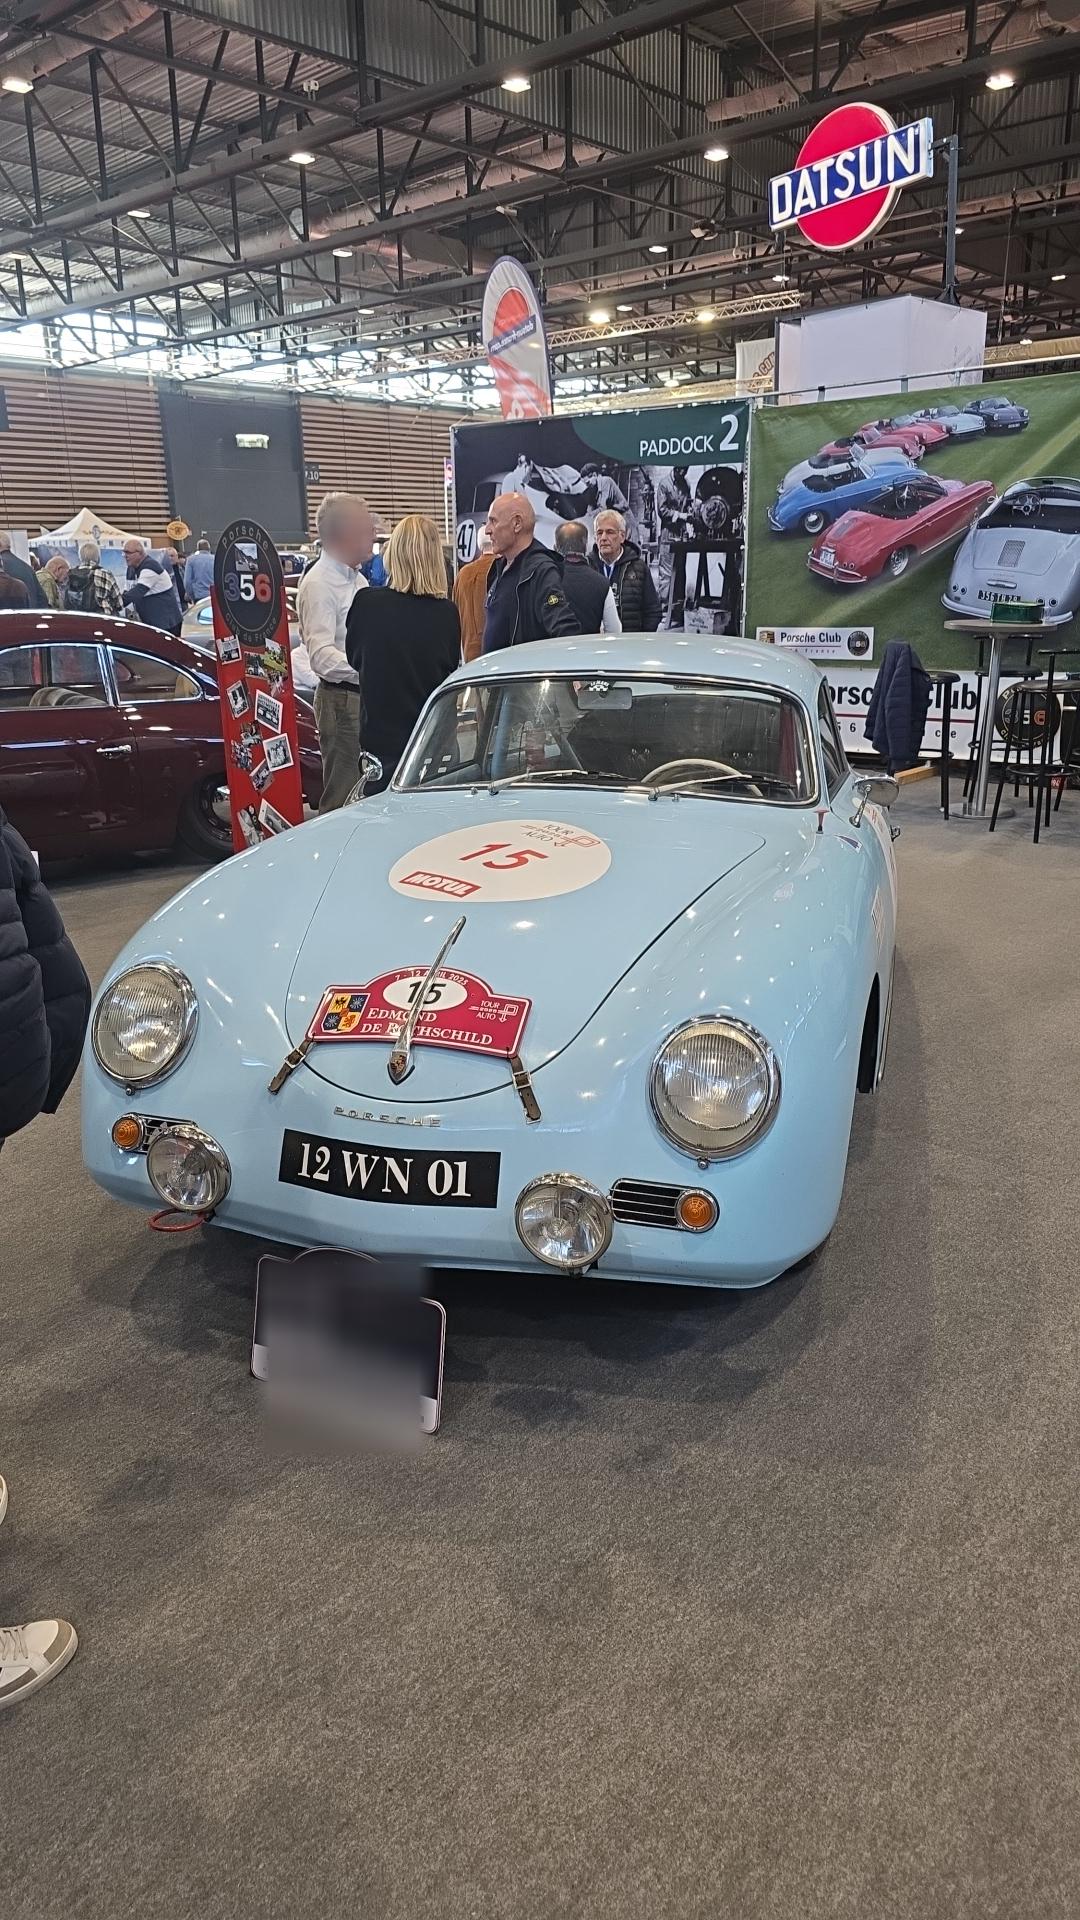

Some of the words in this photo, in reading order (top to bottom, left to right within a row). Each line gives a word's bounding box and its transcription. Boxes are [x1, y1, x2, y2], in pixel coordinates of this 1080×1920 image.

[770, 126, 916, 224] DATSUN
[639, 435, 714, 458] PADDOCK
[719, 414, 740, 452] 2
[222, 525, 269, 550] Porsche
[457, 524, 475, 558] 47
[224, 572, 272, 603] 356
[780, 632, 816, 643] Porsche
[818, 631, 842, 643] Club
[928, 683, 978, 710] lub
[521, 831, 554, 842] AUTO
[458, 843, 549, 870] 15
[405, 873, 474, 897] MOTUL
[447, 973, 469, 986] 2025
[407, 980, 447, 1005] 15
[480, 1000, 501, 1009] TOUR
[360, 1023, 383, 1034] DE
[475, 1012, 496, 1020] AUTO
[333, 1106, 441, 1128] PORSCHE
[297, 1142, 331, 1182] 12
[341, 1149, 414, 1195] WN
[427, 1159, 472, 1198] 01
